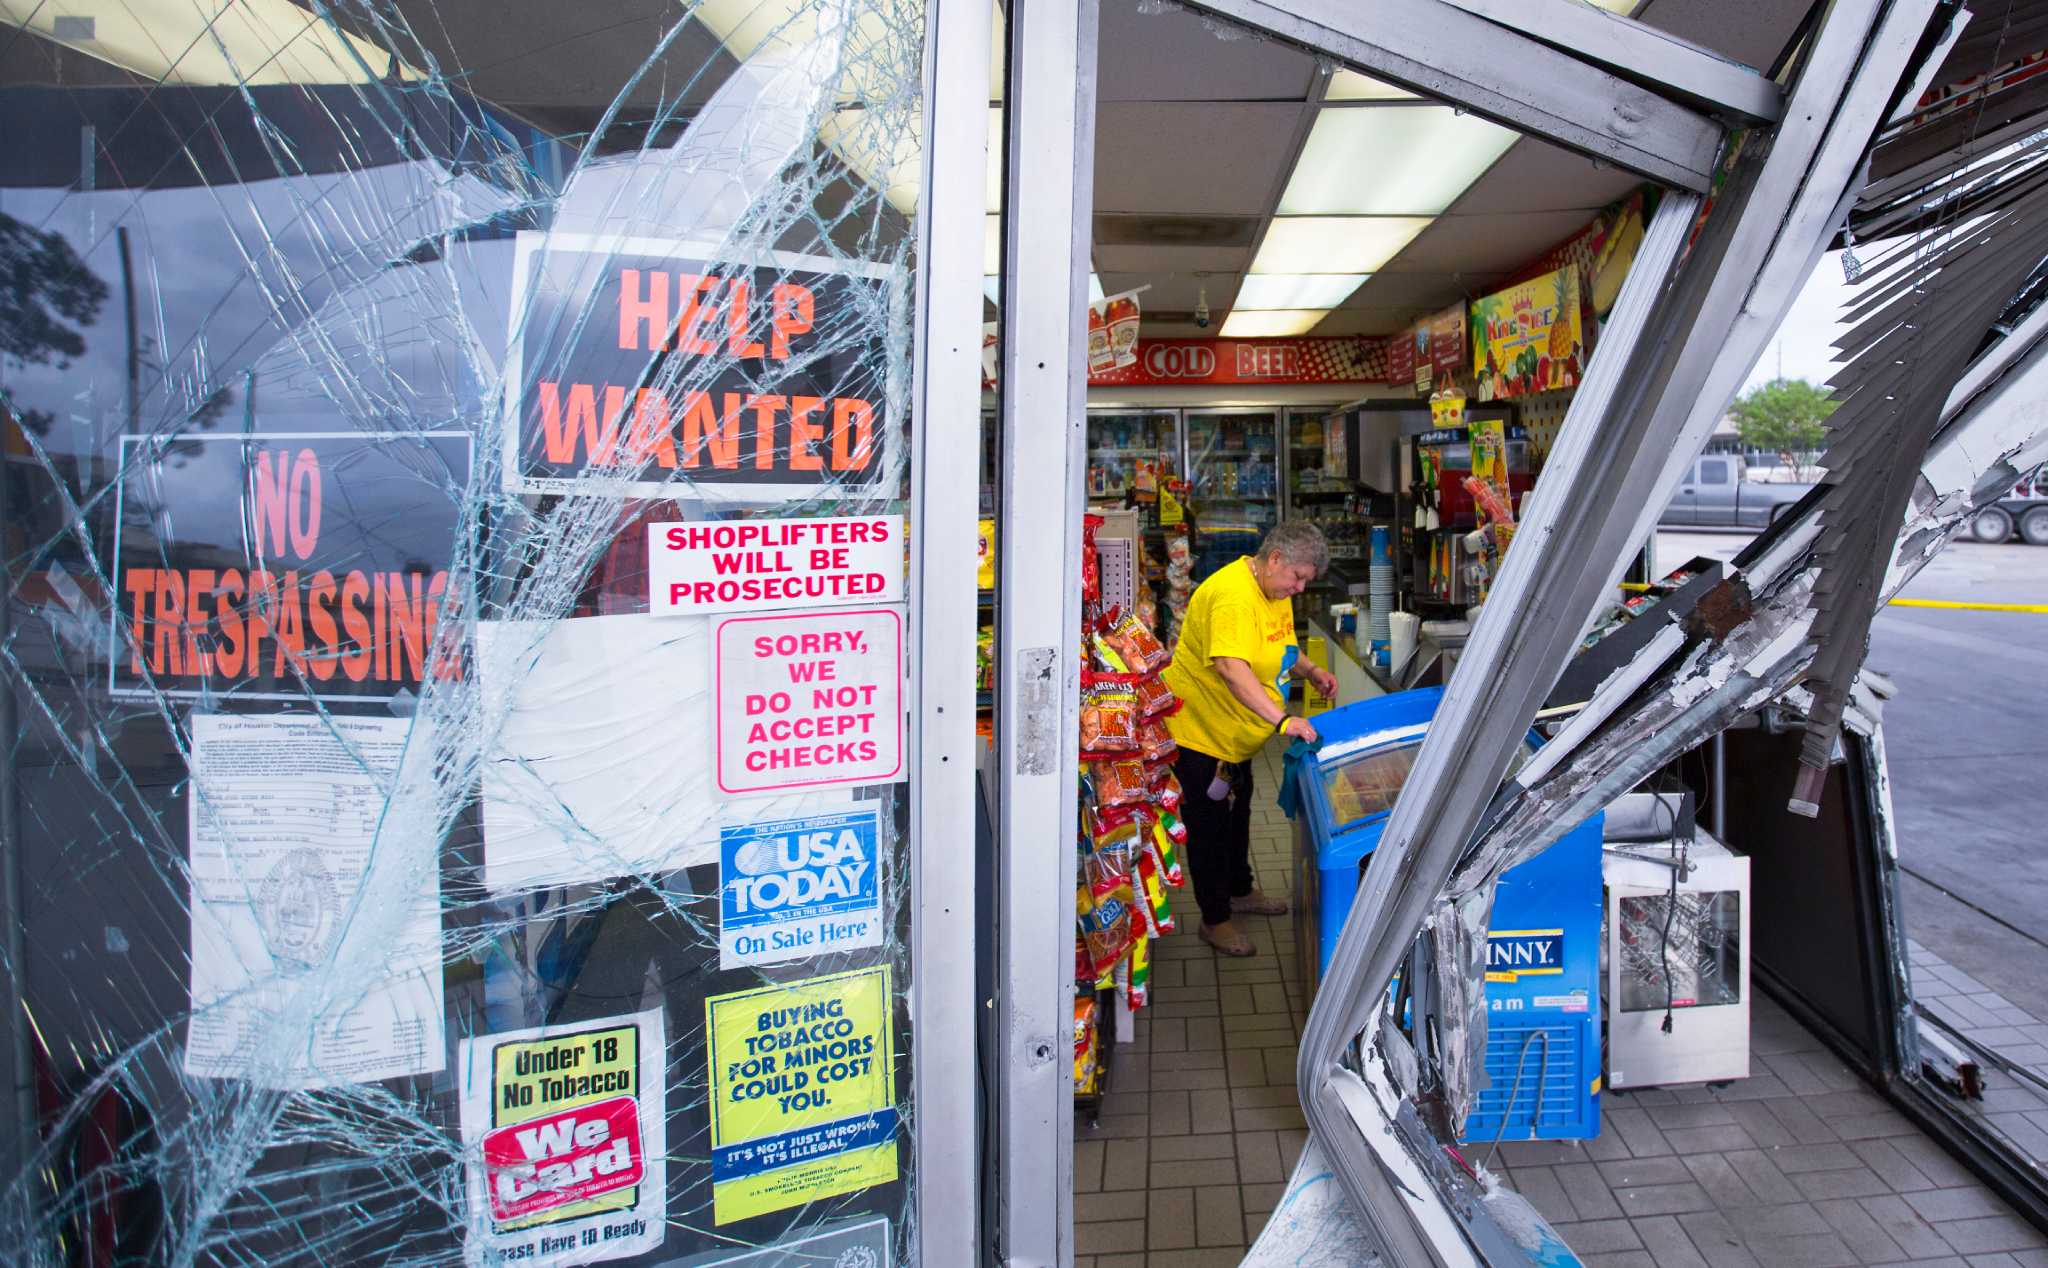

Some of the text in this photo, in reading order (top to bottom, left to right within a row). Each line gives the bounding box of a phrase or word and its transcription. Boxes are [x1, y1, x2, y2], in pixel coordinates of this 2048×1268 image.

[618, 268, 816, 360] HELP
[1145, 344, 1300, 377] COLD BEER
[539, 380, 874, 472] WANTED
[256, 448, 321, 560] NO
[666, 520, 889, 551] SHOPLIFTERS
[712, 548, 850, 575] WILL BE
[670, 573, 886, 605] PROSECUTED
[754, 630, 868, 657] SORRY,
[788, 661, 836, 683] WE
[746, 685, 878, 715] DO NOT
[747, 713, 876, 743] ACCEPT
[745, 741, 878, 772] CHECKS
[777, 829, 865, 870] USA
[729, 861, 871, 913] TODAY
[735, 920, 868, 955] On Sale Here
[758, 998, 843, 1032] BUYING
[745, 1019, 854, 1056] TOBACCO
[516, 1037, 618, 1076] Under 18
[729, 1035, 874, 1081] FOR MINORS
[504, 1069, 630, 1109] No Tobacco
[729, 1057, 872, 1103] COULD COST
[778, 1088, 832, 1114] YOU.
[515, 1117, 610, 1160] We
[728, 1119, 880, 1162] IT'S NOT JUST WRONG,
[763, 1138, 848, 1165] IT'S ILLEGAL.
[496, 1137, 633, 1202] Card
[541, 1234, 576, 1256] Have
[582, 1228, 597, 1246] ID
[604, 1219, 646, 1240] Ready
